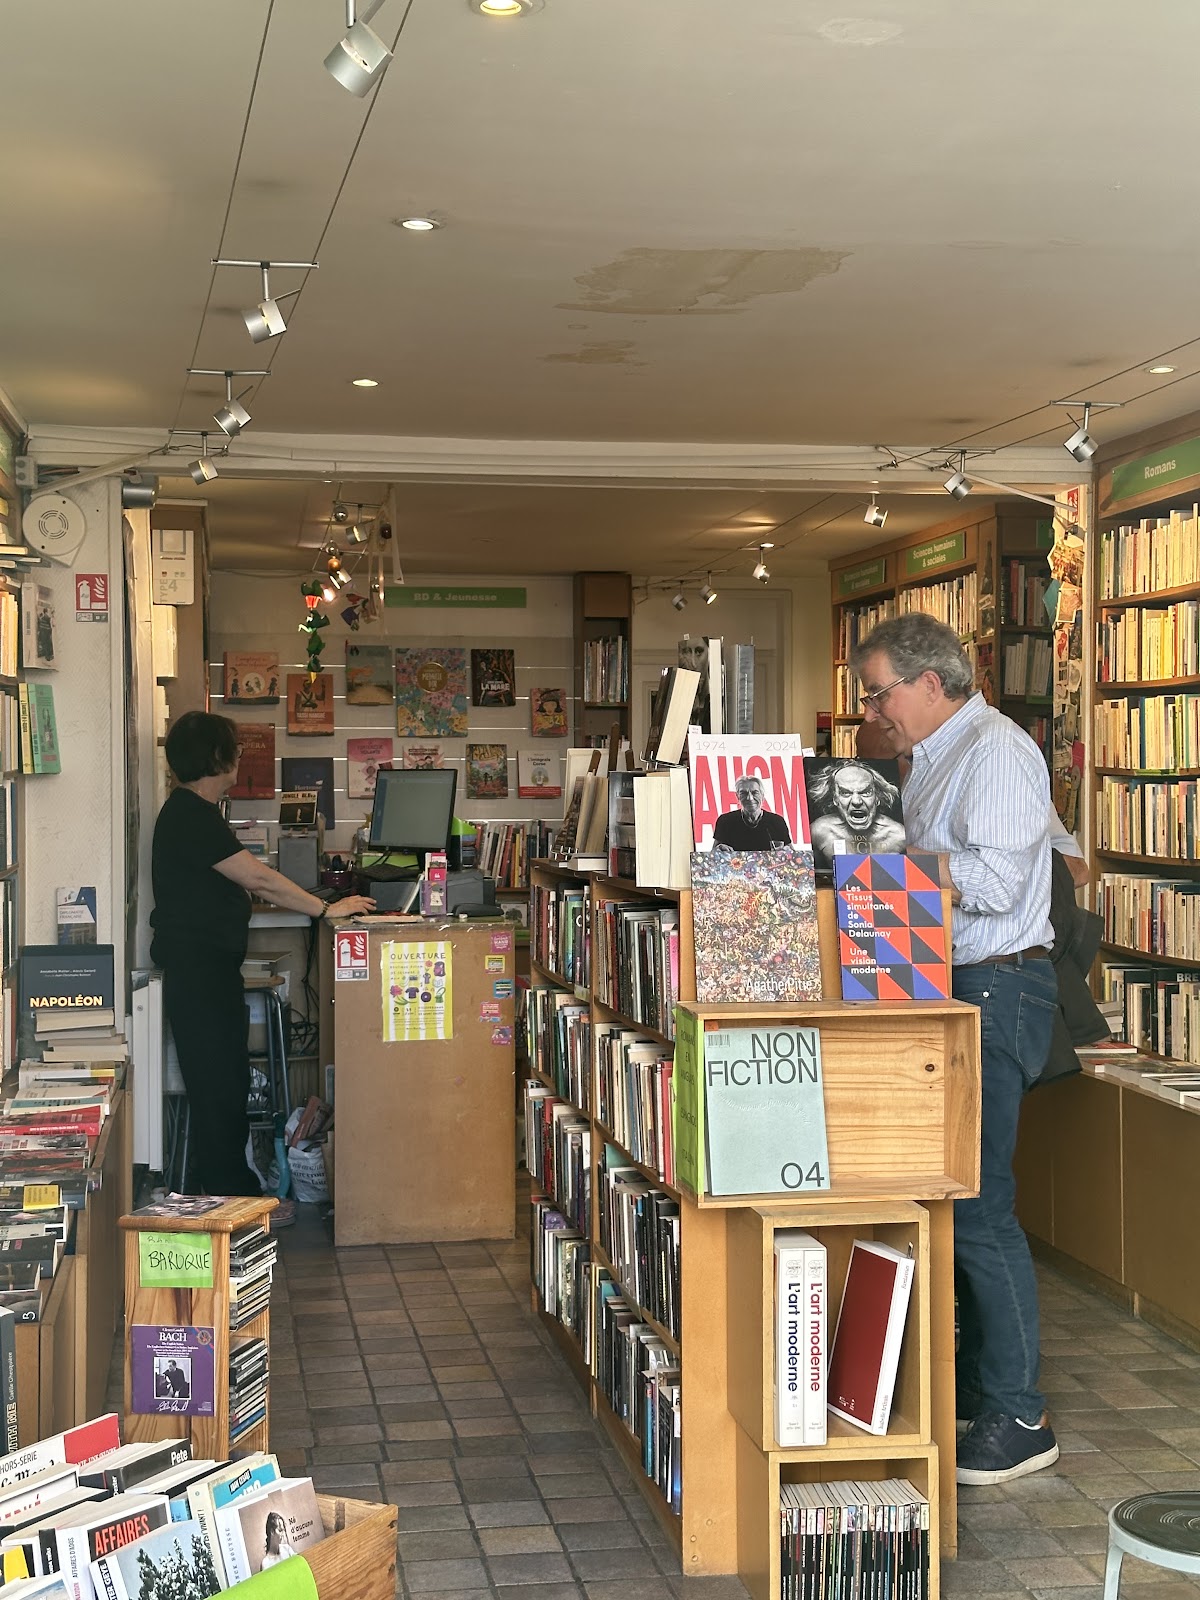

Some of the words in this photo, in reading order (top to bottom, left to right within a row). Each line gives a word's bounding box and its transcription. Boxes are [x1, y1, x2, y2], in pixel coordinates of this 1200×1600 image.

[1145, 460, 1176, 479] Romans
[912, 547, 934, 559] Sciences
[933, 538, 956, 552] humaines
[927, 552, 946, 567] sociales
[160, 579, 168, 602] TYPE
[168, 580, 178, 592] 4
[414, 593, 429, 601] BD
[433, 593, 442, 601] &
[445, 593, 497, 601] Jeunesse
[696, 741, 727, 751] 1974
[765, 741, 797, 751] 2024
[846, 884, 861, 892] Les
[846, 893, 873, 901] Tissus
[846, 902, 894, 910] simultanés
[847, 911, 859, 919] de
[848, 920, 873, 928] Sonia
[848, 930, 891, 938] Delaunay
[390, 952, 446, 960] OUVERTURE
[849, 947, 868, 956] Une
[850, 957, 876, 965] vision
[850, 965, 891, 974] moderne
[746, 977, 784, 994] Agathe
[29, 994, 103, 1008] NAPOLÉON
[751, 1032, 817, 1059] NON
[707, 1057, 818, 1086] FICTION
[780, 1162, 825, 1189] 04
[788, 1283, 801, 1316] L'art
[811, 1283, 823, 1317] L'art
[159, 1332, 187, 1342] BACH
[787, 1319, 800, 1392] moderne
[810, 1320, 822, 1392] moderne
[7, 1402, 17, 1422] ME
[171, 1449, 189, 1466] Pete
[288, 1517, 296, 1526] Né
[95, 1514, 150, 1557] AFFAIRES
[292, 1530, 310, 1543] femme
